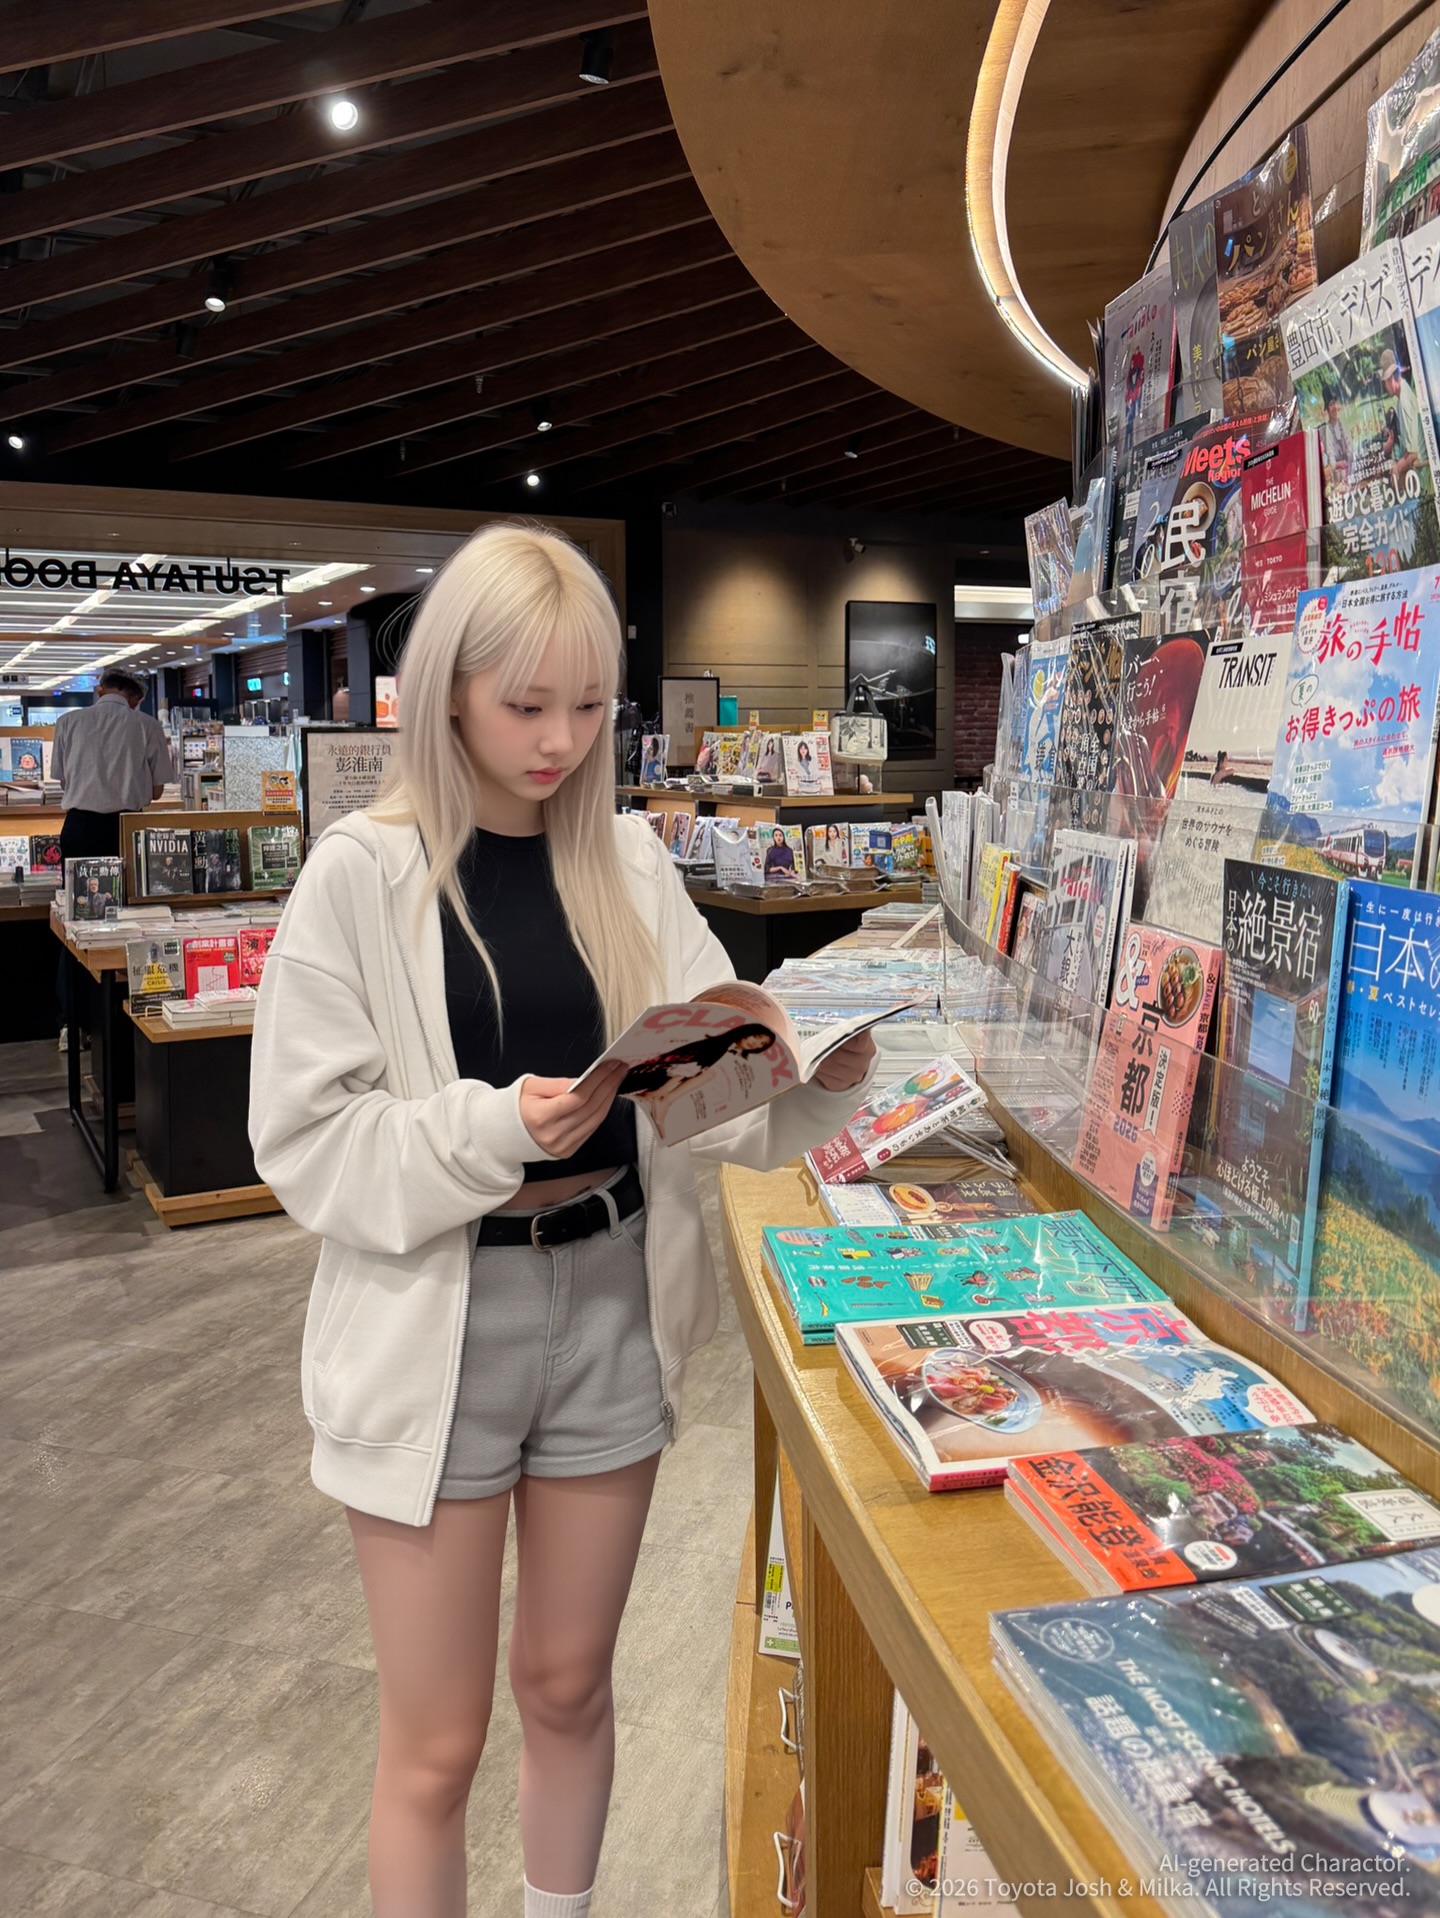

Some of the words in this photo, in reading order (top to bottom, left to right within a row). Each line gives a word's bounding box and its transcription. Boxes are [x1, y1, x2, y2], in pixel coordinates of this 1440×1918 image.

[1286, 308, 1334, 371] 豊田市
[1341, 263, 1393, 340] デイズ
[1180, 436, 1251, 479] Meets
[1251, 482, 1292, 511] MICHELIN
[1263, 506, 1278, 516] GUIDE
[1328, 469, 1421, 524] 遊びと暮らしの
[1343, 509, 1410, 554] 完全ガイド
[1267, 555, 1283, 565] TOKYO
[1317, 600, 1426, 667] 旅の手帖
[1219, 652, 1278, 689] TRANSIT
[1284, 682, 1423, 744] お得きっぷの旅
[336, 756, 383, 773] 彭淮南
[150, 839, 189, 853] NVIDIA
[1181, 818, 1233, 837] 世界のサウナを
[1185, 837, 1220, 853] めぐる冒険
[1258, 872, 1315, 900] 今こそ行きたい
[1225, 889, 1238, 952] 日本の
[1236, 889, 1323, 984] 絶景宿
[642, 1007, 794, 1088] CLASY.
[1120, 1001, 1166, 1118] 京都
[1113, 1115, 1138, 1144] 2026
[1216, 1159, 1289, 1230] 心ほどける極上の旅へ!
[1007, 1305, 1191, 1353] 京都
[1028, 1456, 1146, 1550] 金沢能登
[1115, 1658, 1151, 1685] THE
[1137, 1686, 1190, 1728] MOST
[1174, 1729, 1239, 1788] SCENIC
[1224, 1787, 1297, 1854] HOTELS
